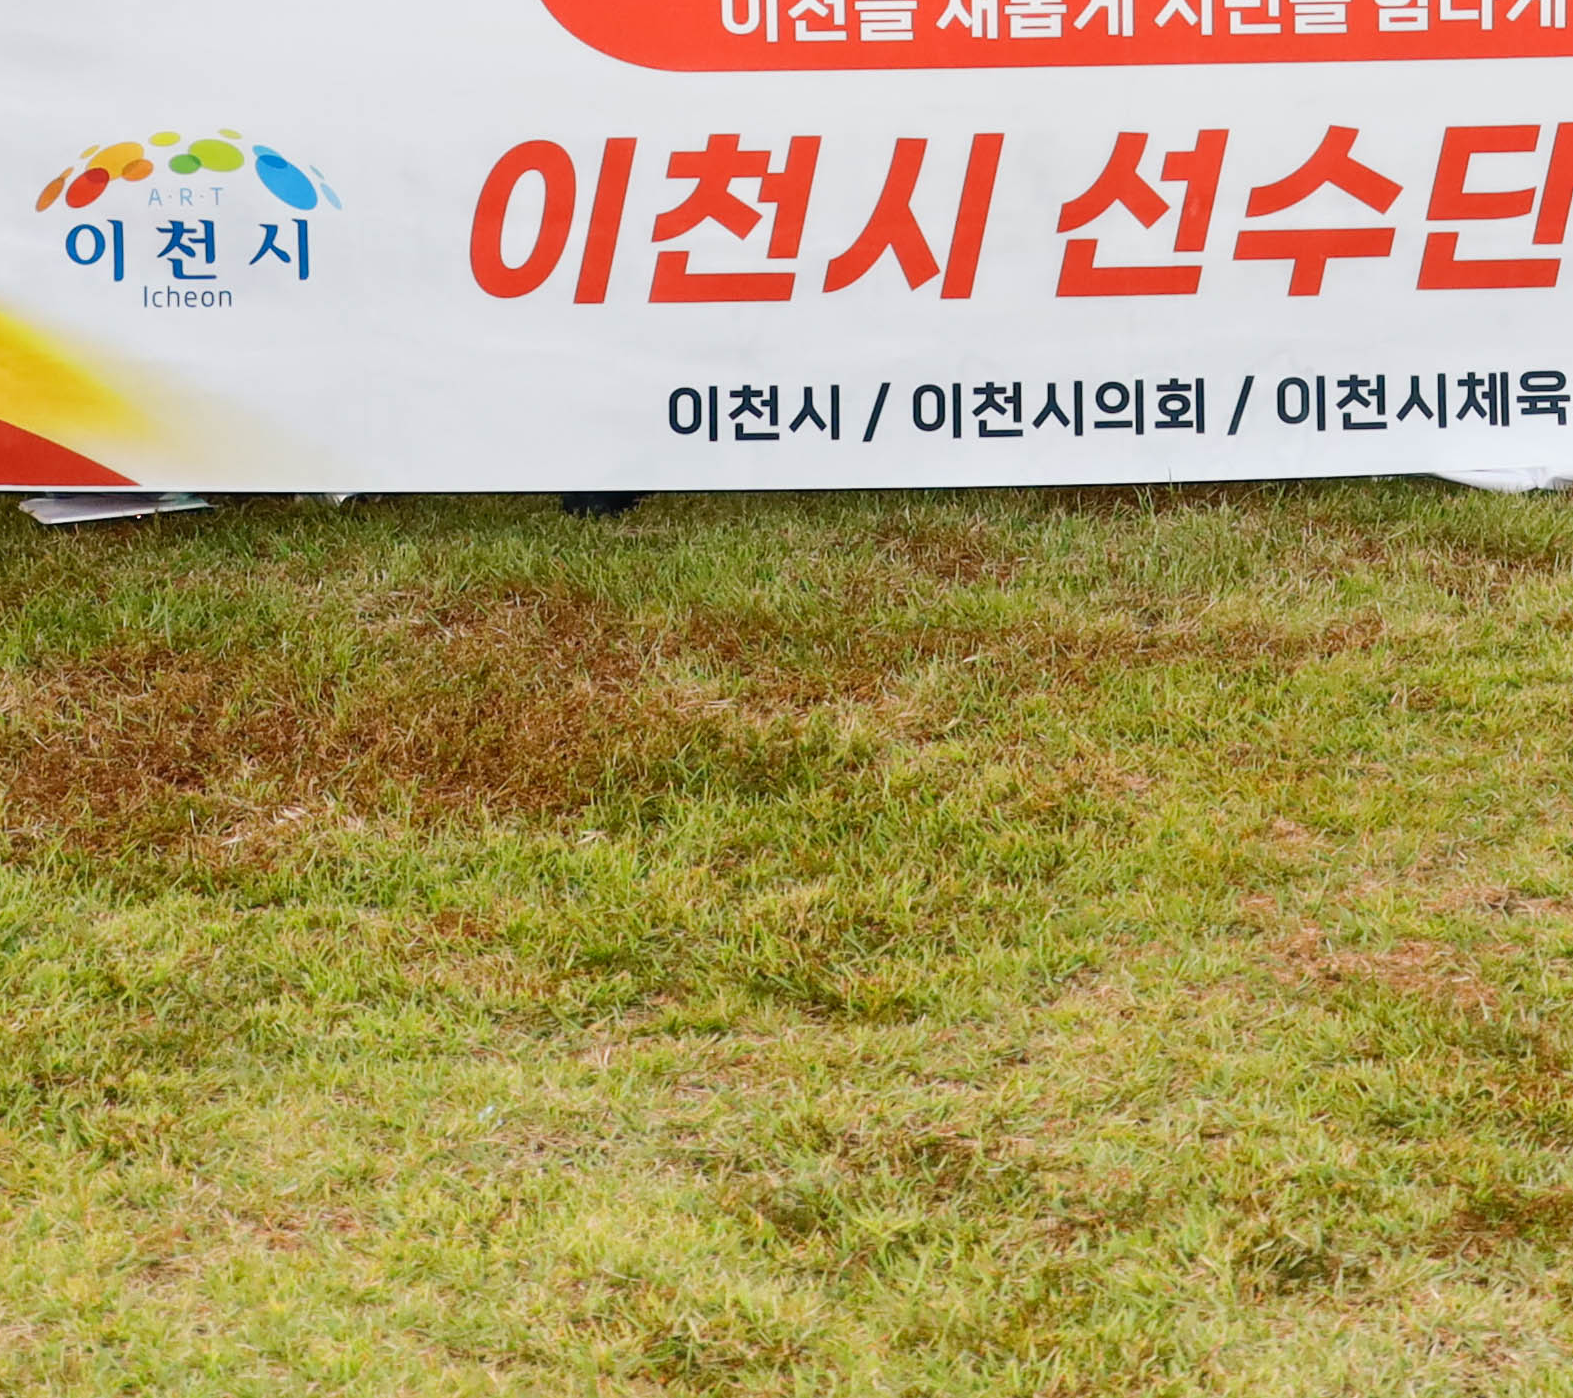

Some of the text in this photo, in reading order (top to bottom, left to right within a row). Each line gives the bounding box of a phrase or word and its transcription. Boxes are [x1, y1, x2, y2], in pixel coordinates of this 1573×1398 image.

[65, 219, 309, 281] 이천시
[469, 132, 1004, 305] 이천시
[144, 286, 232, 307] Icheon
[667, 385, 842, 442] 이천시
[912, 377, 1207, 438] 이천시의회
